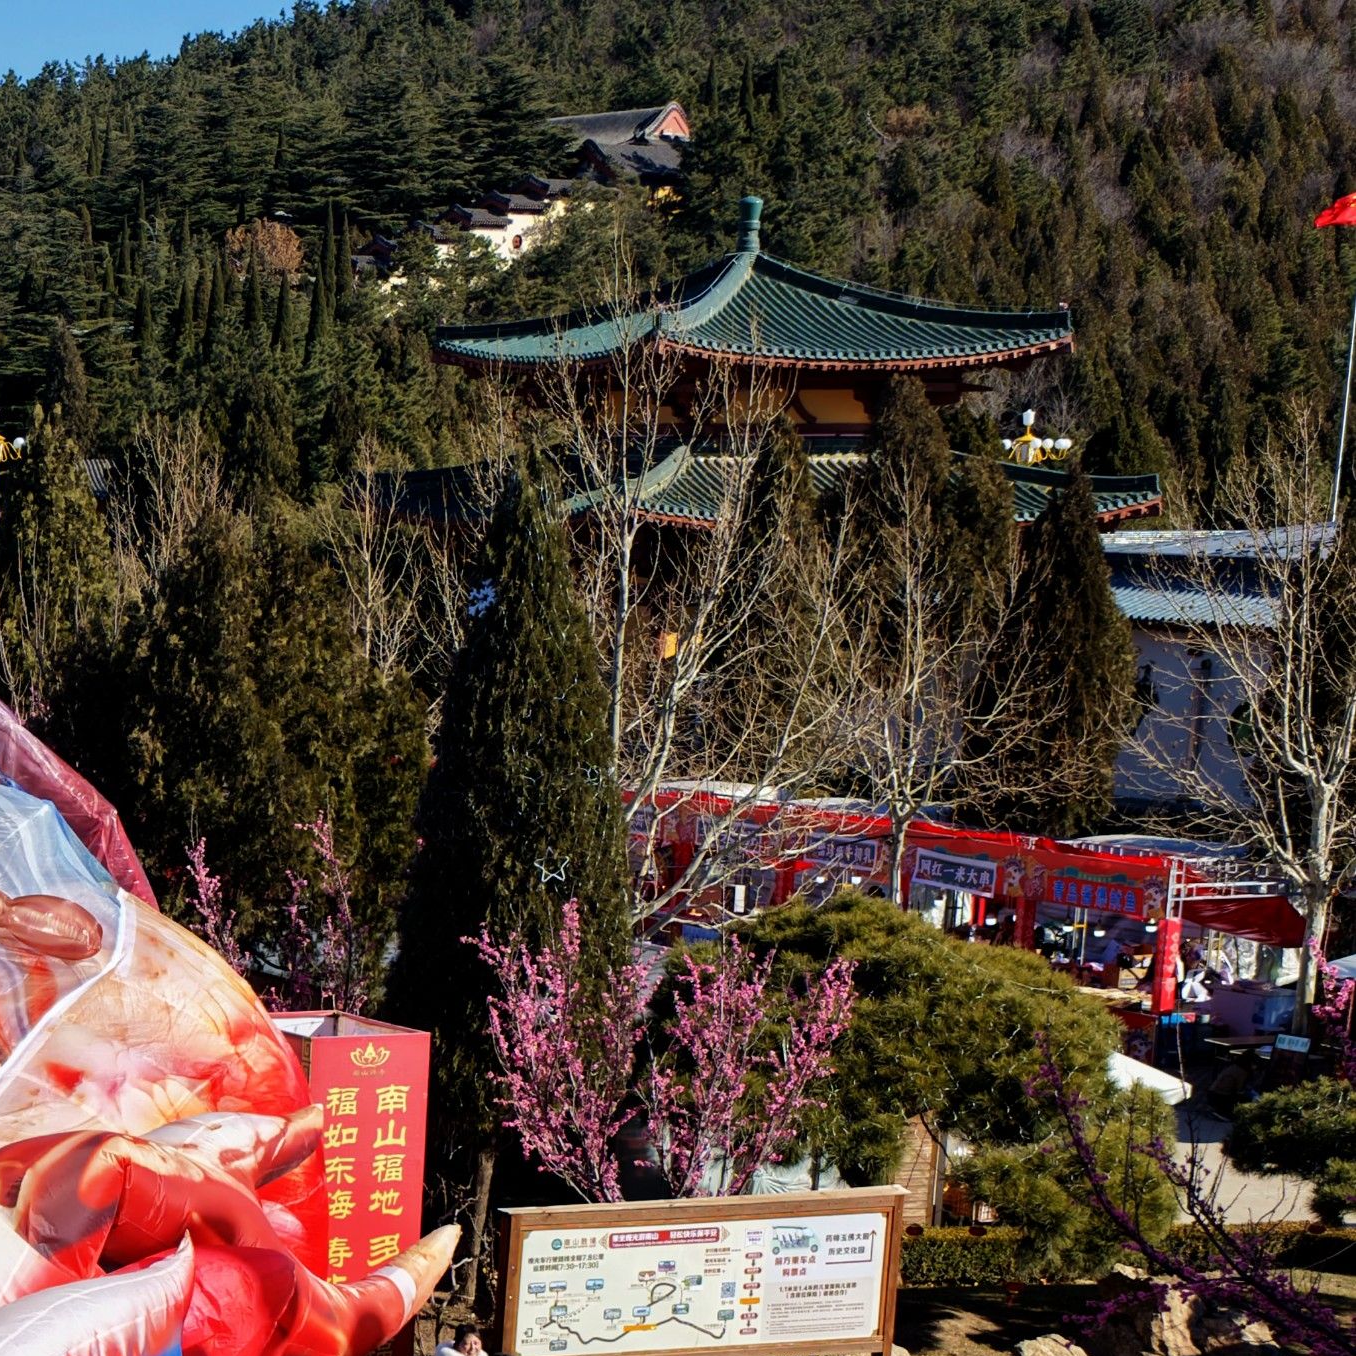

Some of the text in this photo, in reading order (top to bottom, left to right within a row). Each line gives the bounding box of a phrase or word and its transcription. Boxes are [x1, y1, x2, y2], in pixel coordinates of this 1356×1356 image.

[323, 1087, 360, 1220] 福如东海
[368, 1084, 410, 1216] 南山福地
